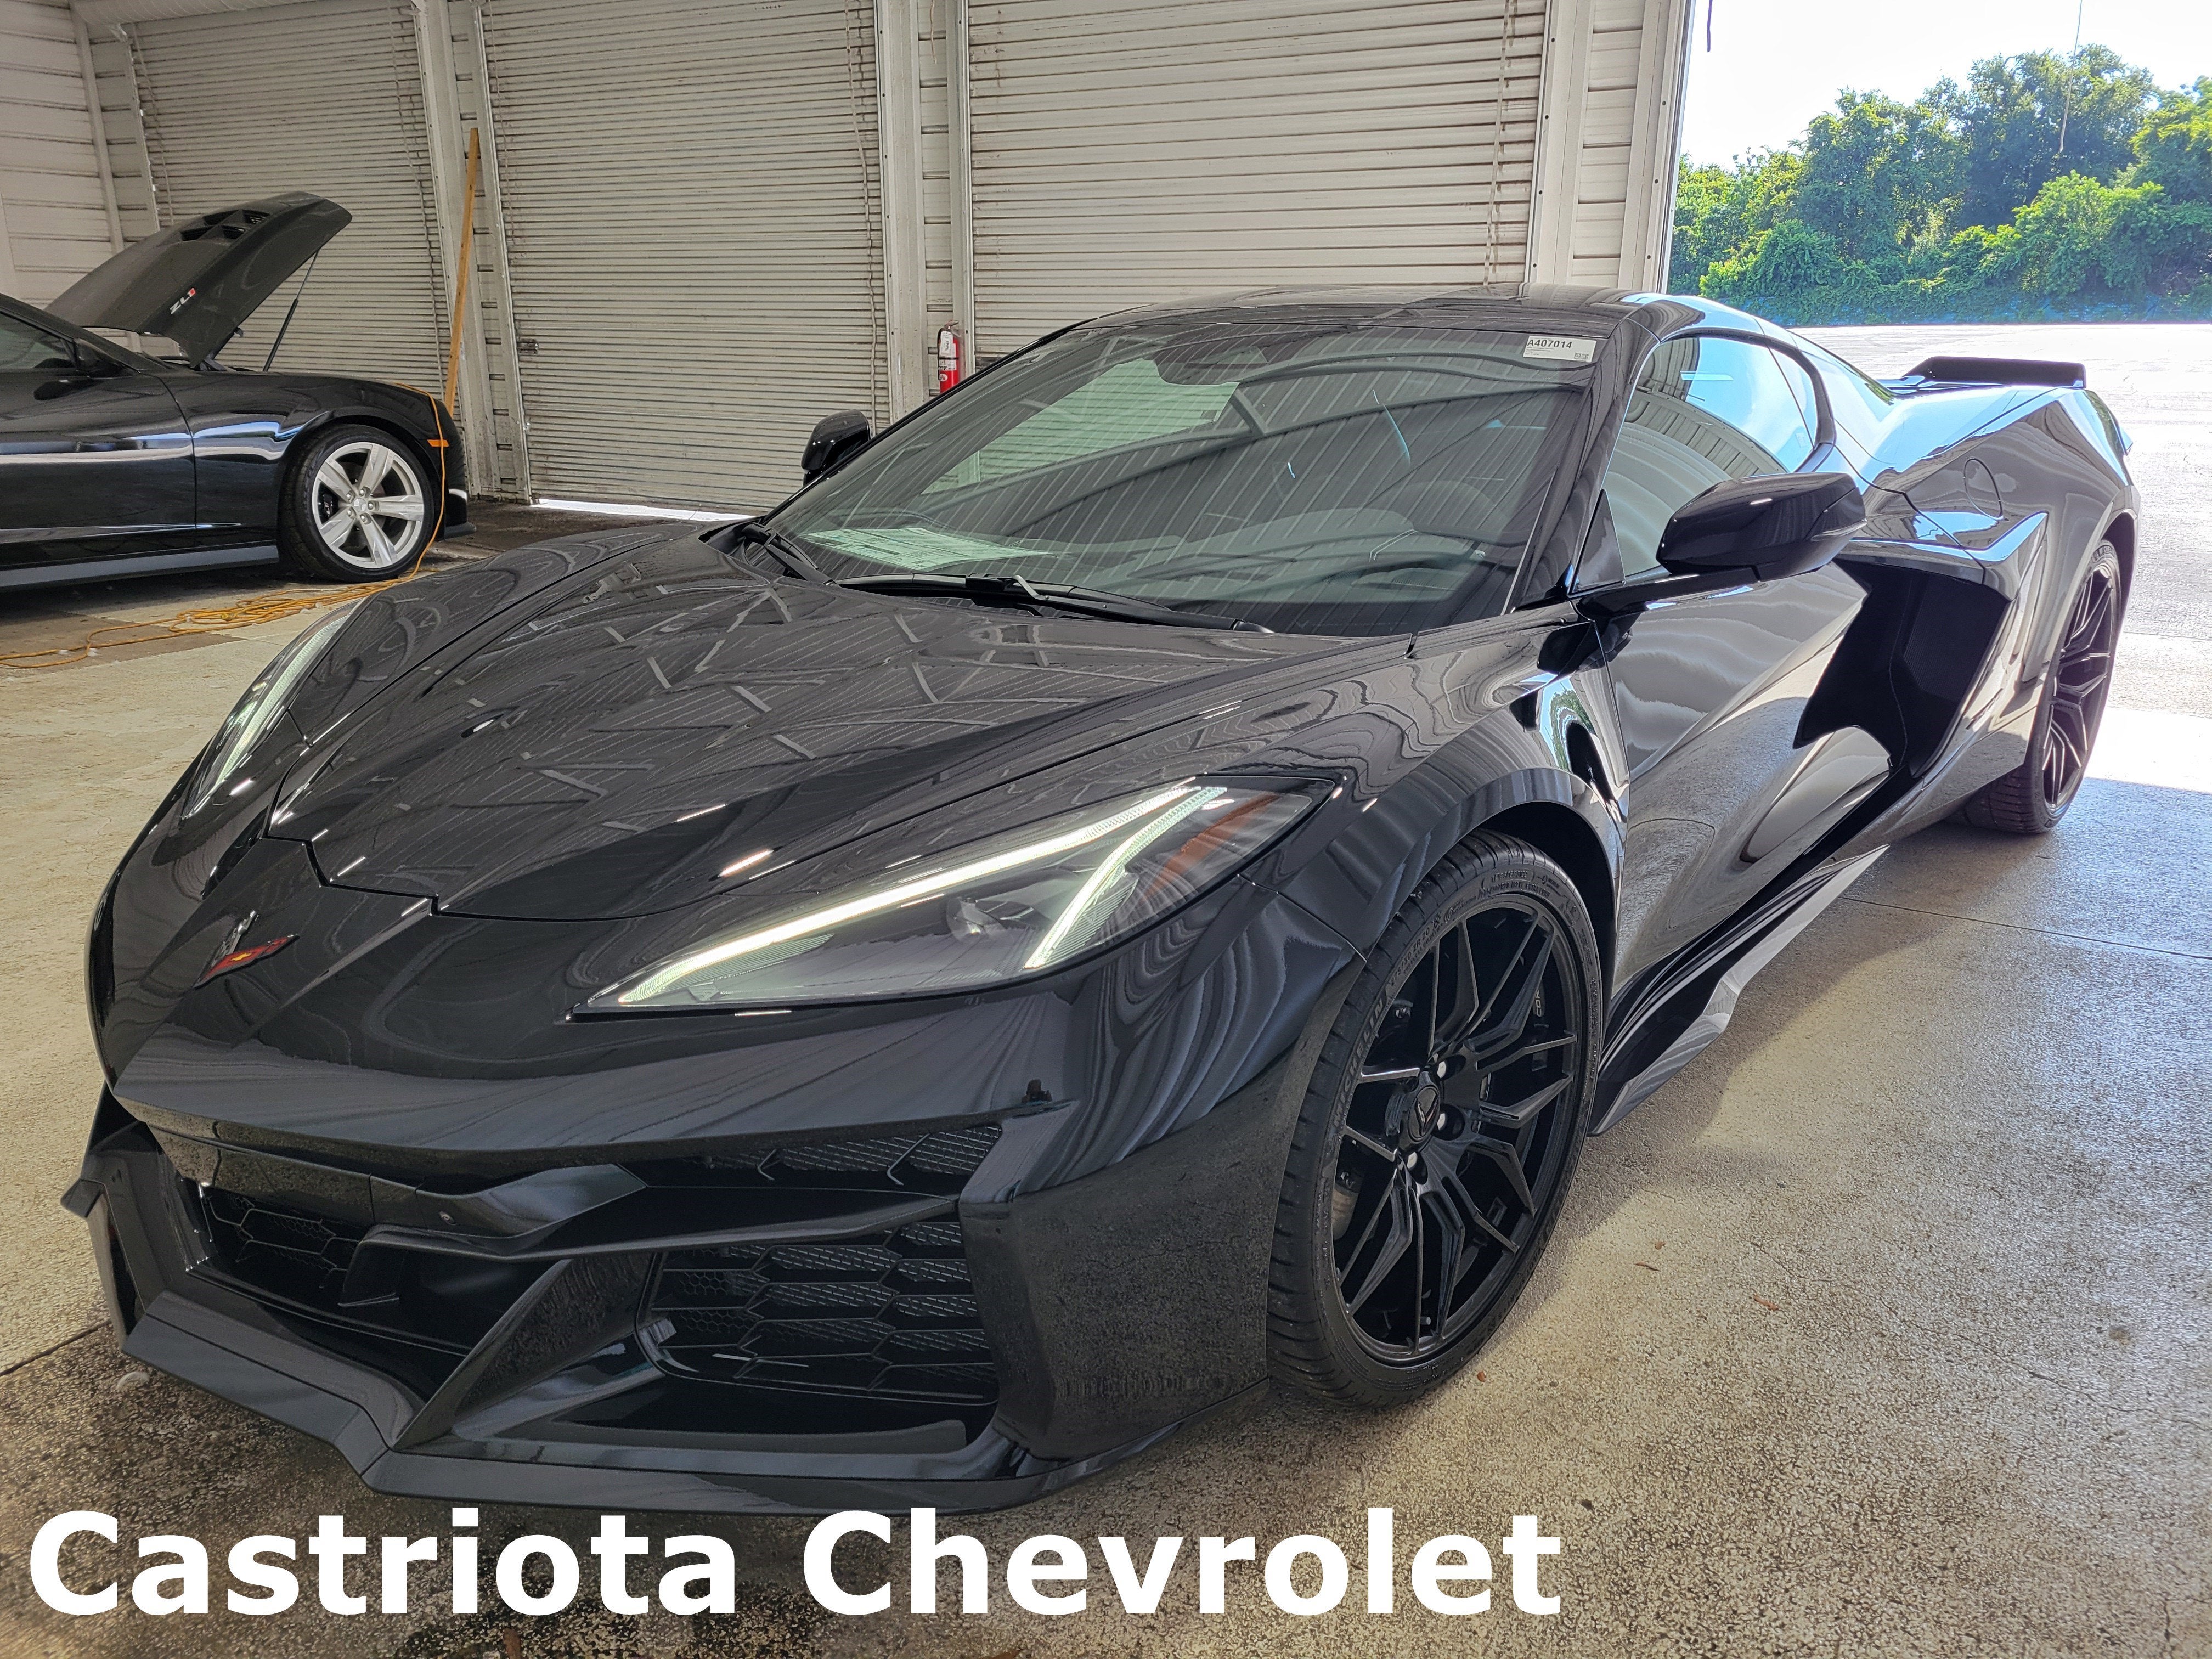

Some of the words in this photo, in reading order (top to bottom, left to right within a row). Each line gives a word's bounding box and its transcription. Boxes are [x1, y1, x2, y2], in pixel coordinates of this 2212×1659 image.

[169, 287, 195, 314] ZL1
[1527, 339, 1572, 349] A407014
[1333, 997, 1384, 1128] MICHELIN
